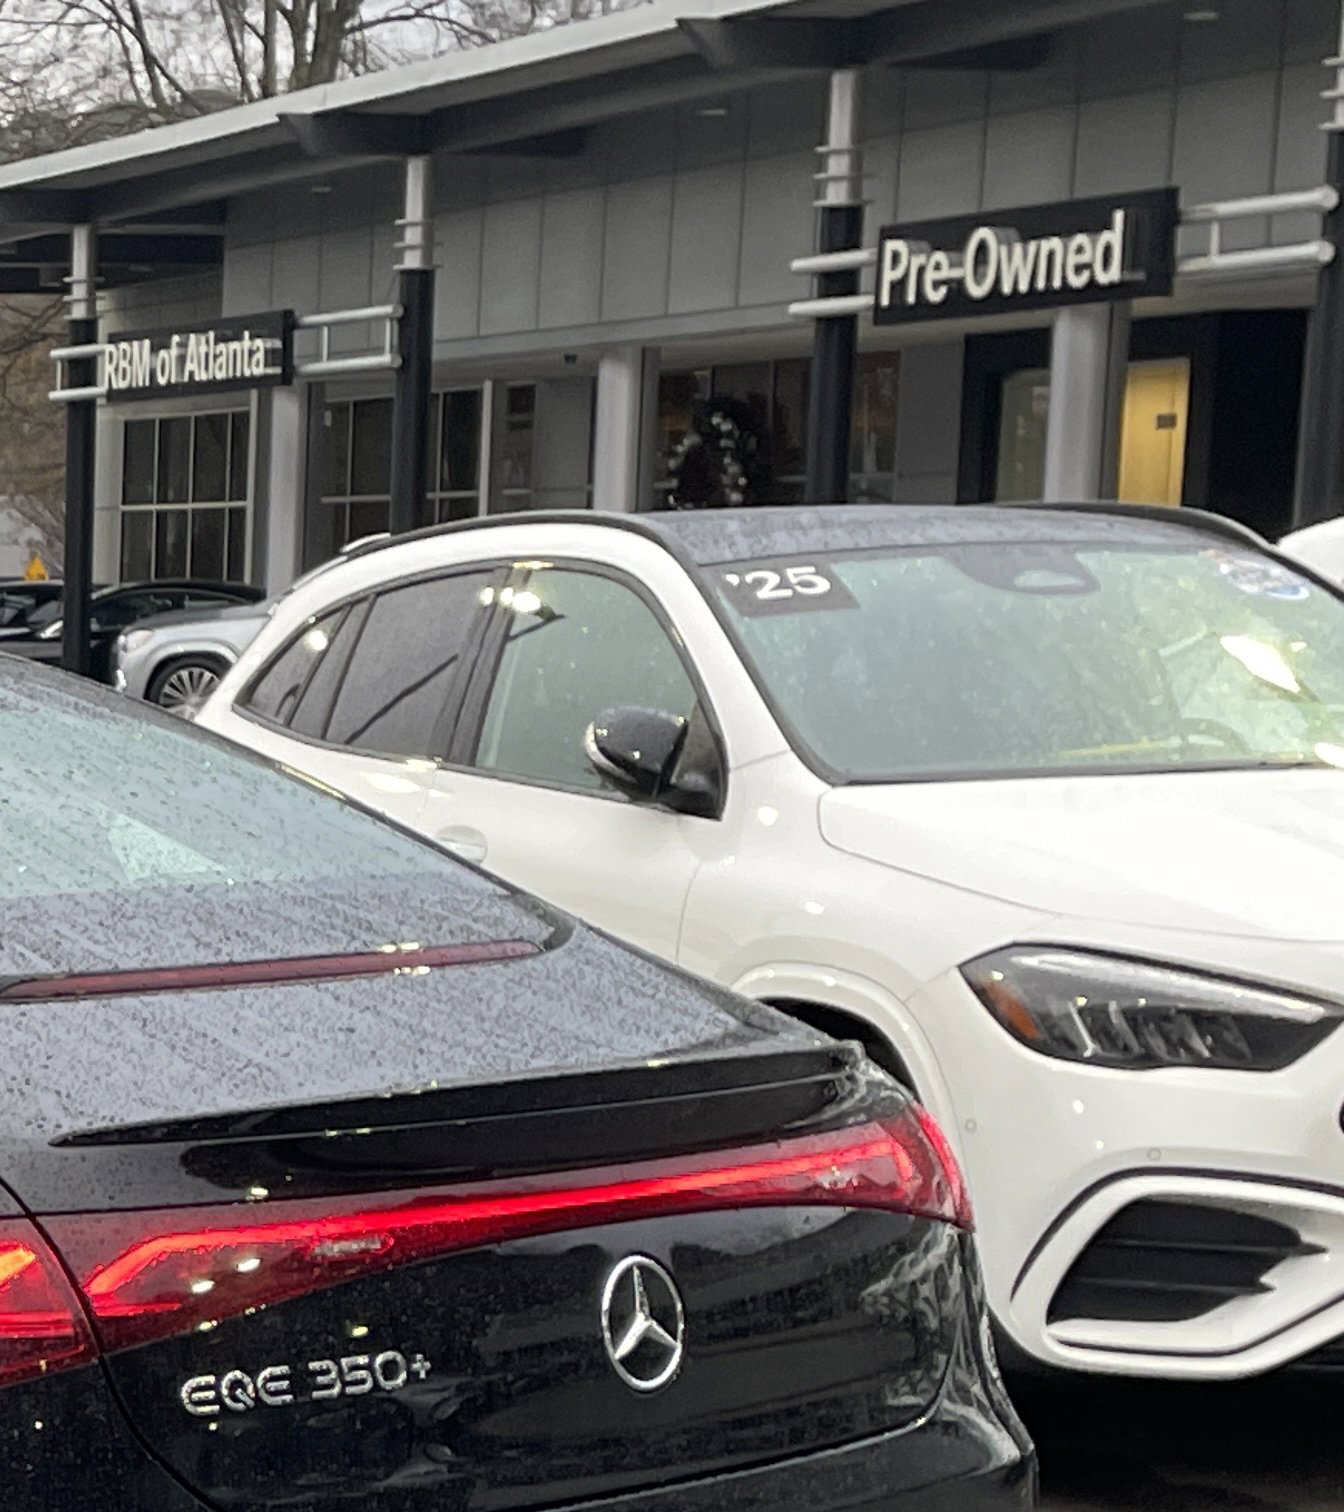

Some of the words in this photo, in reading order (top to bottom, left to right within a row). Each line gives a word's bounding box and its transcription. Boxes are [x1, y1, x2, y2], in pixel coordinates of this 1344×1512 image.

[880, 208, 1126, 308] Pre-Owned
[105, 338, 151, 389] RBM
[156, 334, 180, 386] of
[183, 330, 266, 381] Atlanta
[181, 1365, 294, 1416] EQE
[308, 1350, 432, 1400] 350+
